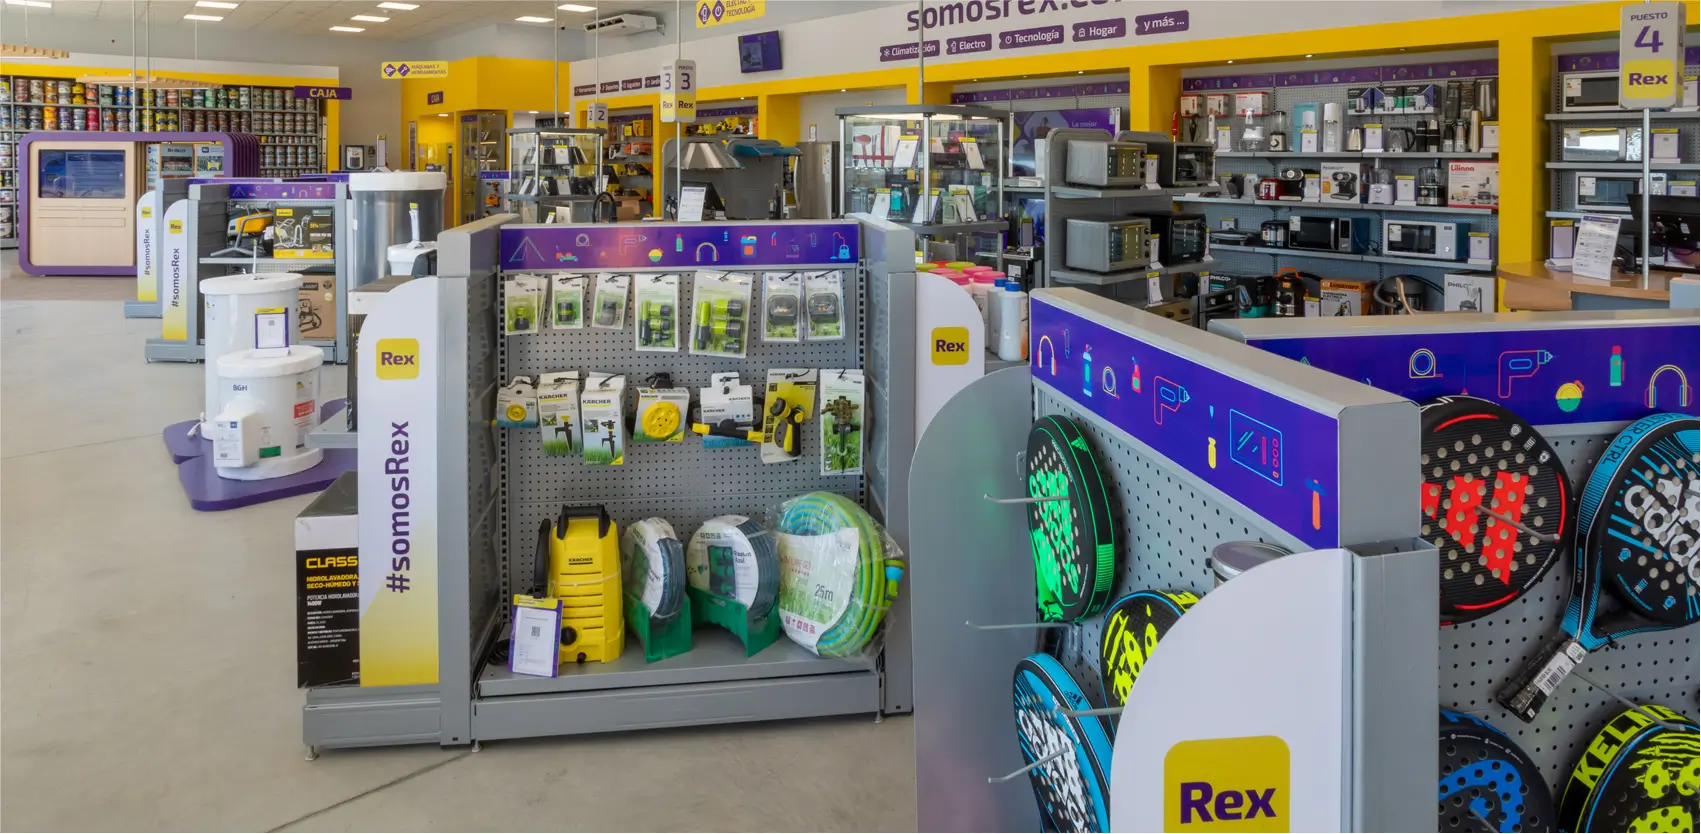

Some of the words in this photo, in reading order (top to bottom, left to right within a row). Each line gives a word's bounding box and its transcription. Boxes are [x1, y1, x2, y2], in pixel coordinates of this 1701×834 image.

[1143, 21, 1151, 31] y
[1151, 16, 1175, 28] más
[1630, 12, 1668, 21] PUESTO
[1014, 30, 1060, 45] Tecnología
[1089, 25, 1118, 37] Hogar
[959, 41, 986, 51] Electro
[1634, 25, 1664, 53] 4
[664, 72, 672, 90] 3
[681, 72, 691, 90] 3
[1628, 72, 1669, 86] Rex
[309, 88, 338, 98] CAJA
[678, 100, 694, 109] Rex
[597, 110, 605, 121] 2
[1450, 164, 1475, 172] Liliana
[143, 229, 151, 276] #somosRex
[171, 248, 180, 307] #somosRex
[935, 339, 965, 353] Rex
[381, 351, 415, 366] Rex
[1601, 435, 1634, 465] CTRL
[385, 420, 411, 594] #somosRex
[815, 584, 834, 601] 25m
[1179, 781, 1277, 824] Rex
